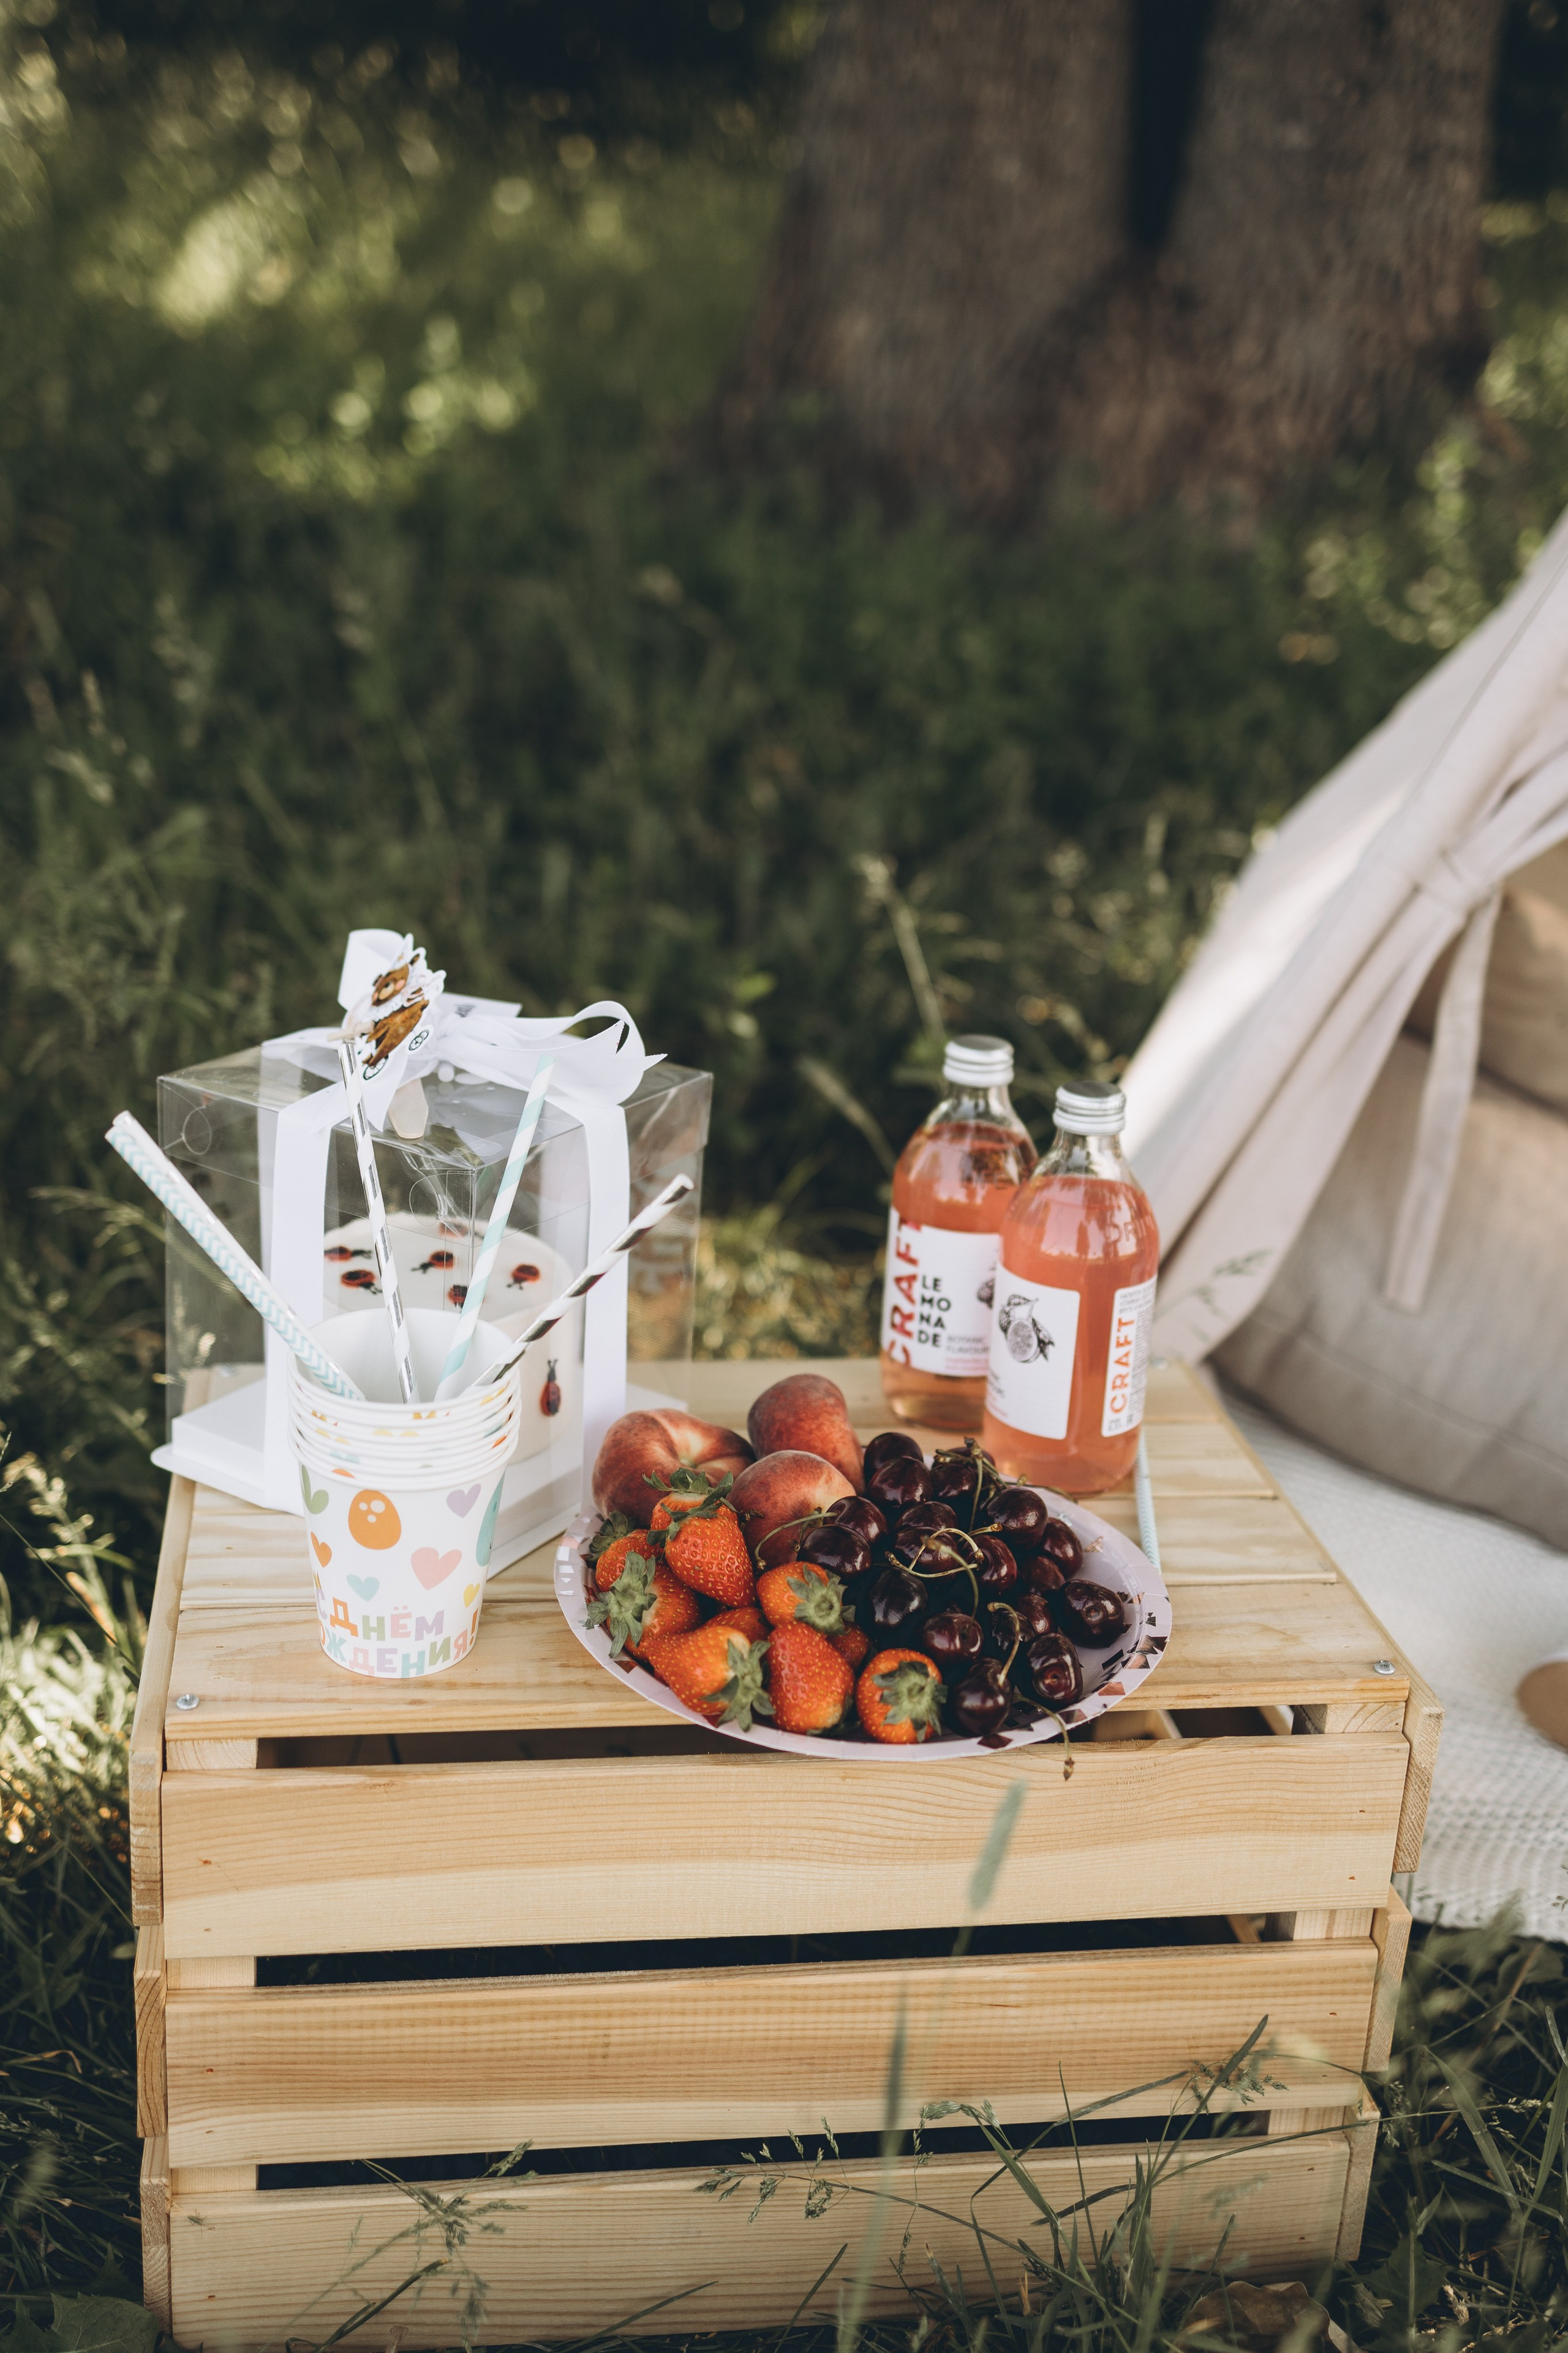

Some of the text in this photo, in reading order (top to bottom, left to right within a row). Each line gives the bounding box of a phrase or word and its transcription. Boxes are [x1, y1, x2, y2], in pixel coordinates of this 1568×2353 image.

[922, 1275, 942, 1292] LE
[921, 1294, 951, 1312] MO
[920, 1312, 946, 1330] NA
[918, 1331, 941, 1348] DE
[1110, 1318, 1135, 1414] CRAFT
[330, 1596, 445, 1642] ДНЁМ
